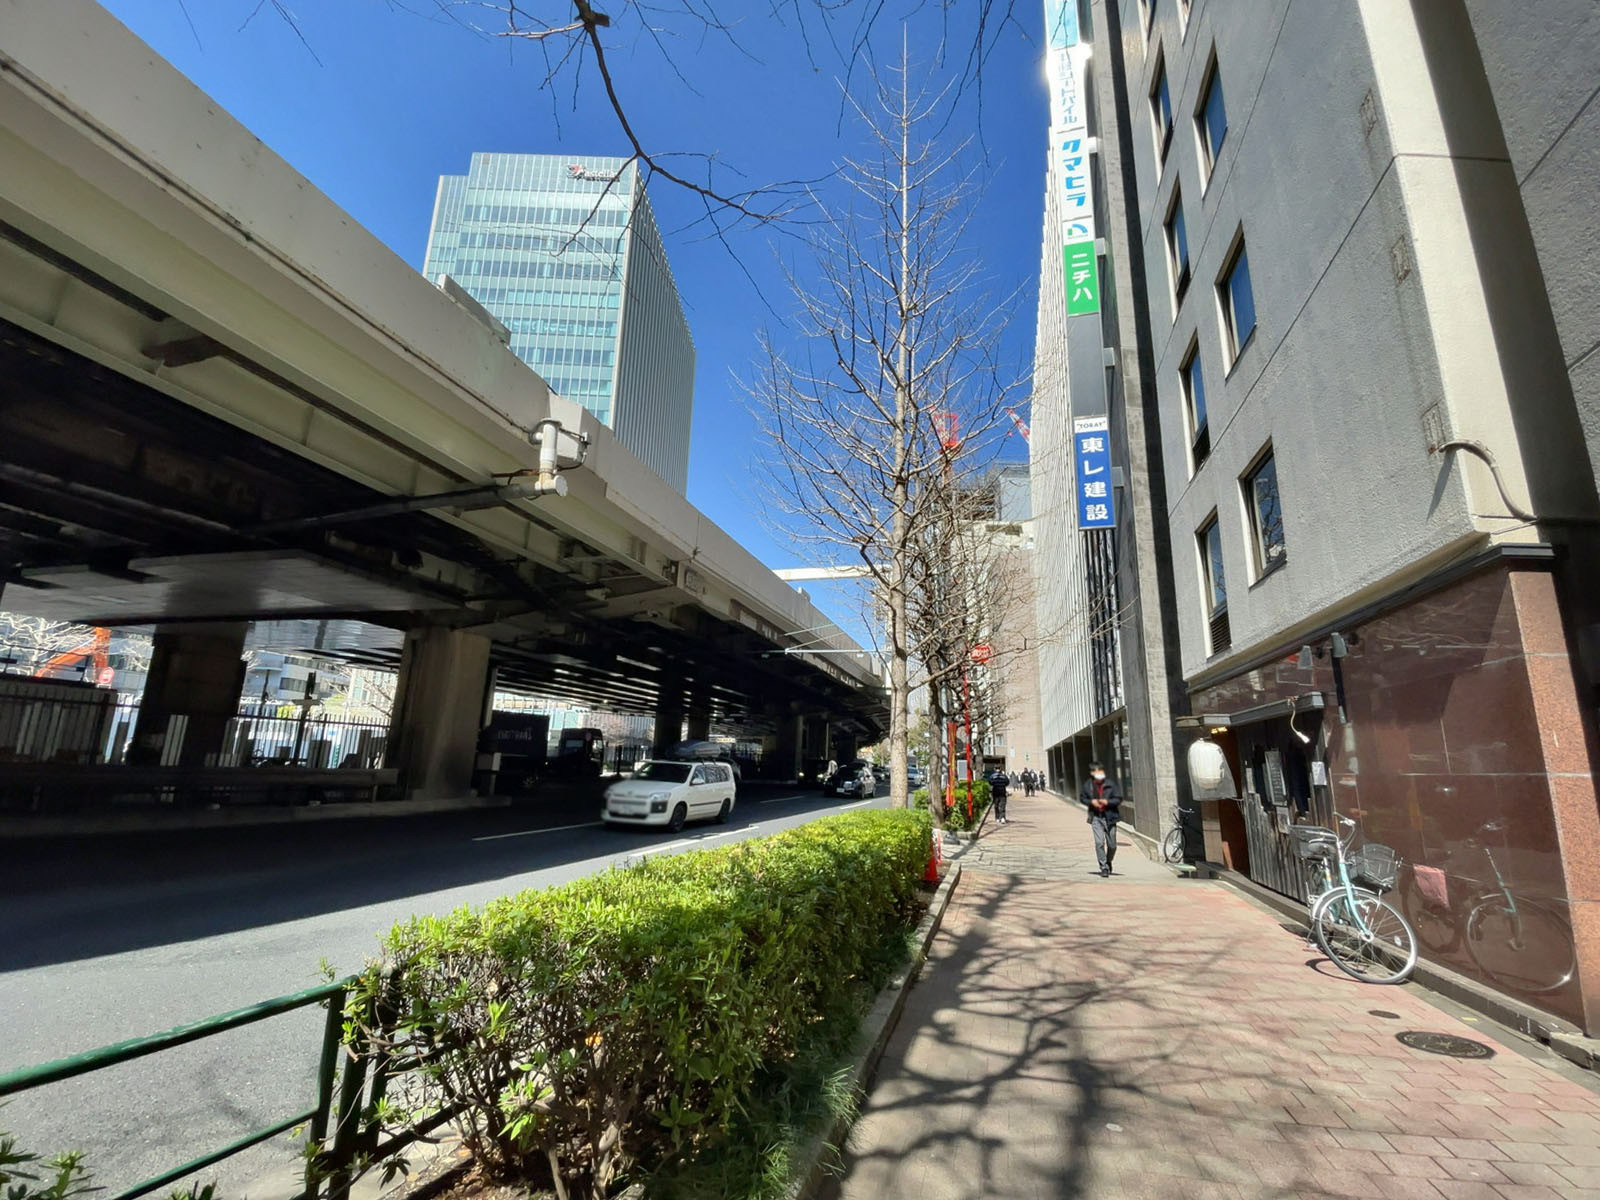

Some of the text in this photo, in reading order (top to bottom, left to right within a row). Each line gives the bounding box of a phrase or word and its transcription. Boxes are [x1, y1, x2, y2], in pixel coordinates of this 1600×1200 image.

[1062, 139, 1087, 207] クマヒラ
[1071, 252, 1093, 302] ニチハ
[1081, 437, 1109, 521] 東レ建設
